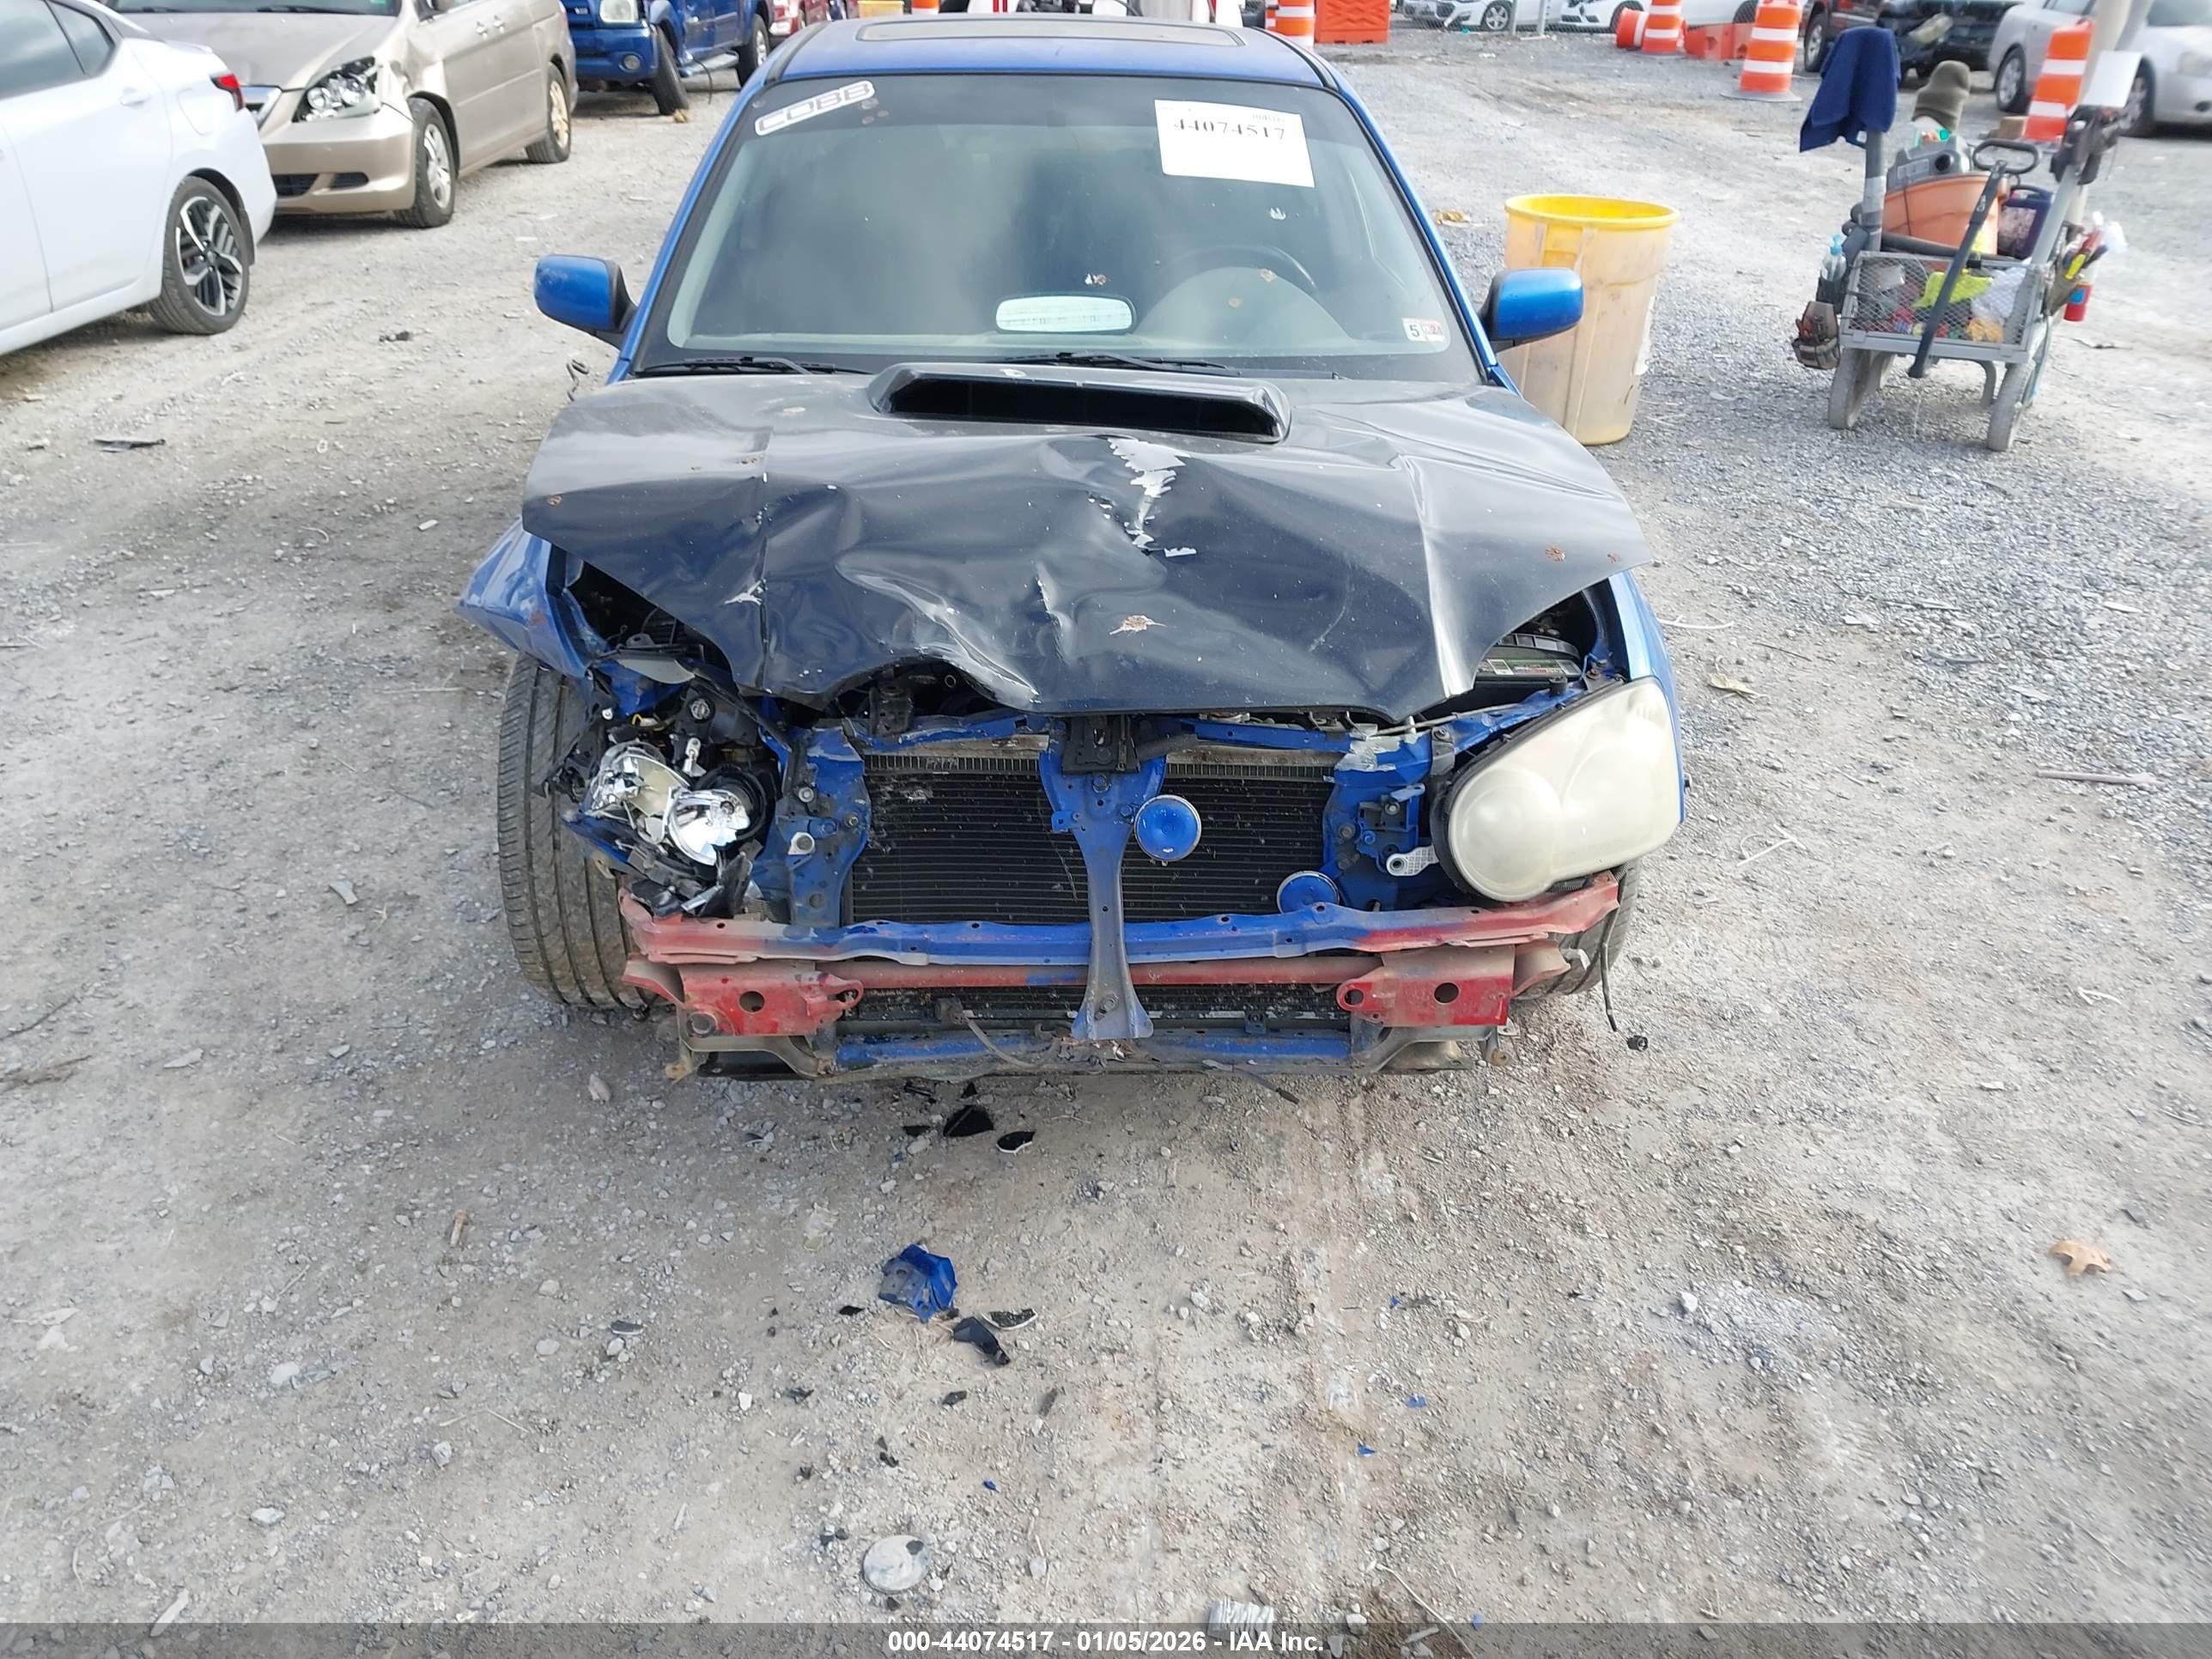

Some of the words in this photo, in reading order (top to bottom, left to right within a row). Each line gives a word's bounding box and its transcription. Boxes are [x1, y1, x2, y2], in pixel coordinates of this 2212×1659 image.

[758, 82, 872, 132] COBB
[1174, 118, 1285, 140] 44074517
[1408, 323, 1420, 337] 5
